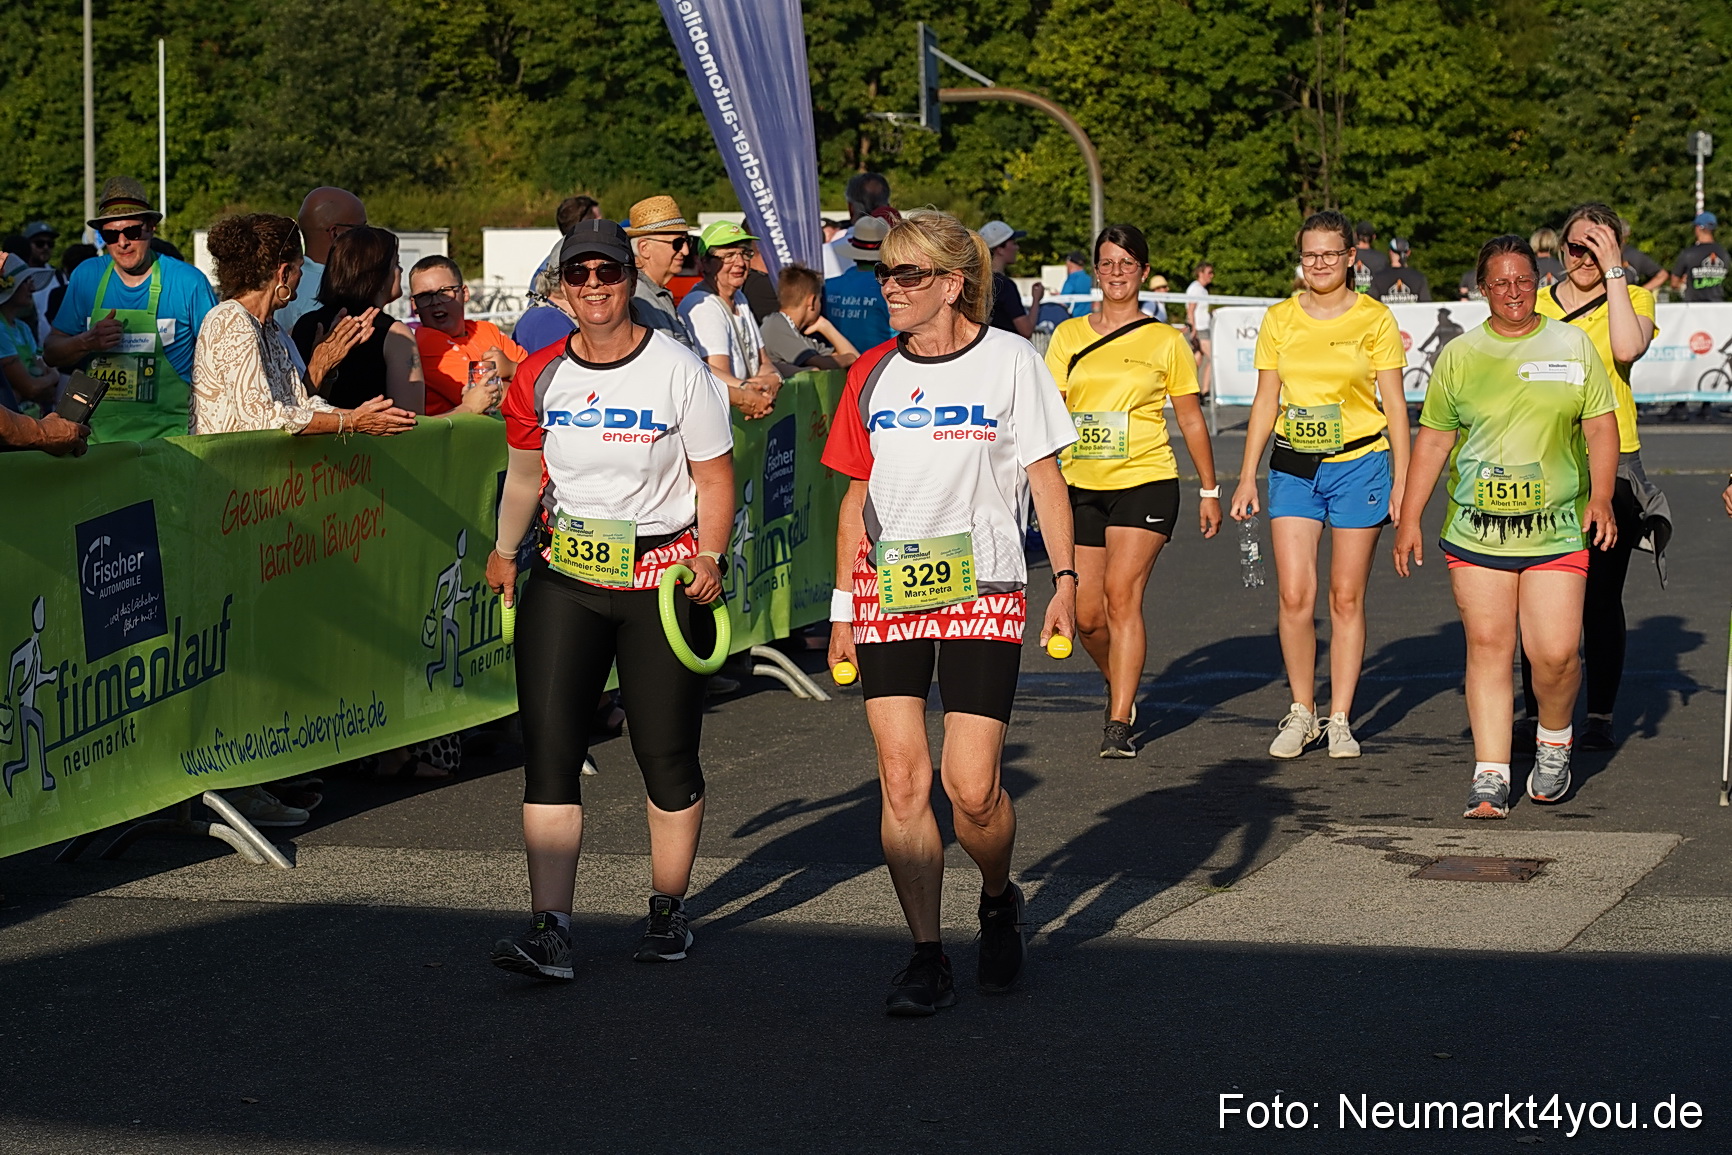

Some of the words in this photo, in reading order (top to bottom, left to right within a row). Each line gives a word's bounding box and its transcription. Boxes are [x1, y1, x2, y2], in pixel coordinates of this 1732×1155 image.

[933, 425, 996, 442] energie
[1082, 428, 1111, 443] 552
[1296, 422, 1327, 437] 558
[222, 460, 306, 535] Gesunde
[311, 453, 371, 502] Firmen
[1486, 481, 1530, 499] 1511
[260, 521, 317, 583] laufen
[323, 488, 386, 563] länger!
[566, 537, 610, 563] 338
[620, 547, 629, 577] 2022
[93, 551, 144, 586] Fischer
[559, 555, 593, 571] Lehmeier
[595, 564, 620, 577] Sonja
[901, 561, 951, 588] 329
[962, 560, 972, 591] 2022
[99, 575, 141, 599] AUTOMOBILE
[883, 569, 893, 603] WALK
[904, 589, 927, 598] Marx
[929, 586, 952, 595] Petra
[57, 594, 232, 742] firmenlauf
[180, 690, 388, 776] www.firmenlauf-oberpfalz.de
[64, 718, 136, 777] neumarkt
